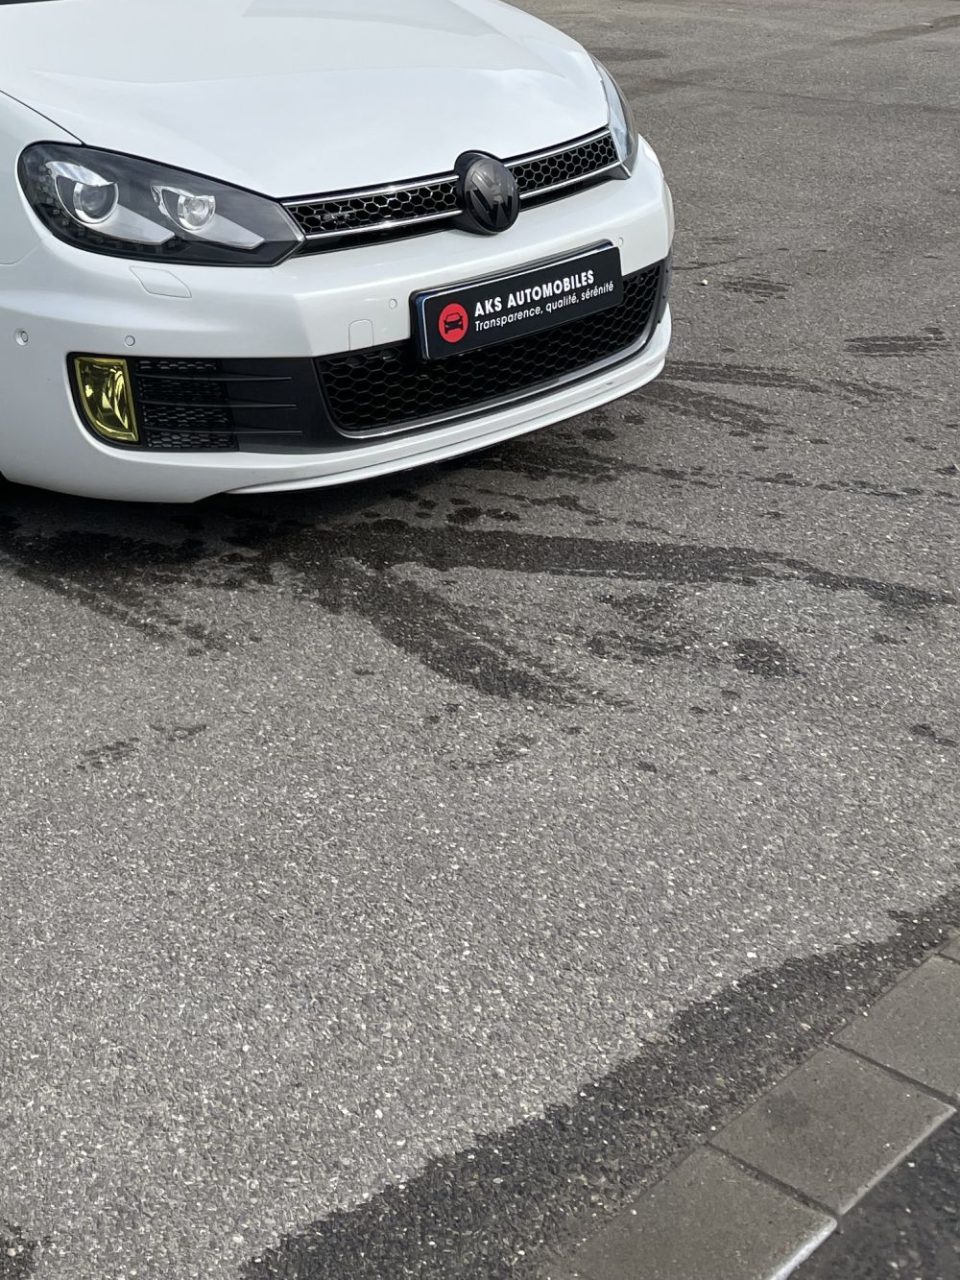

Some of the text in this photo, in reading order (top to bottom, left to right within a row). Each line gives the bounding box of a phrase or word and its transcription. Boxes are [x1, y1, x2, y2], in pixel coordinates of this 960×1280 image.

[474, 270, 594, 317] AKS AUTOMOBILES
[474, 281, 614, 332] Transparence, qualité, sérénité
